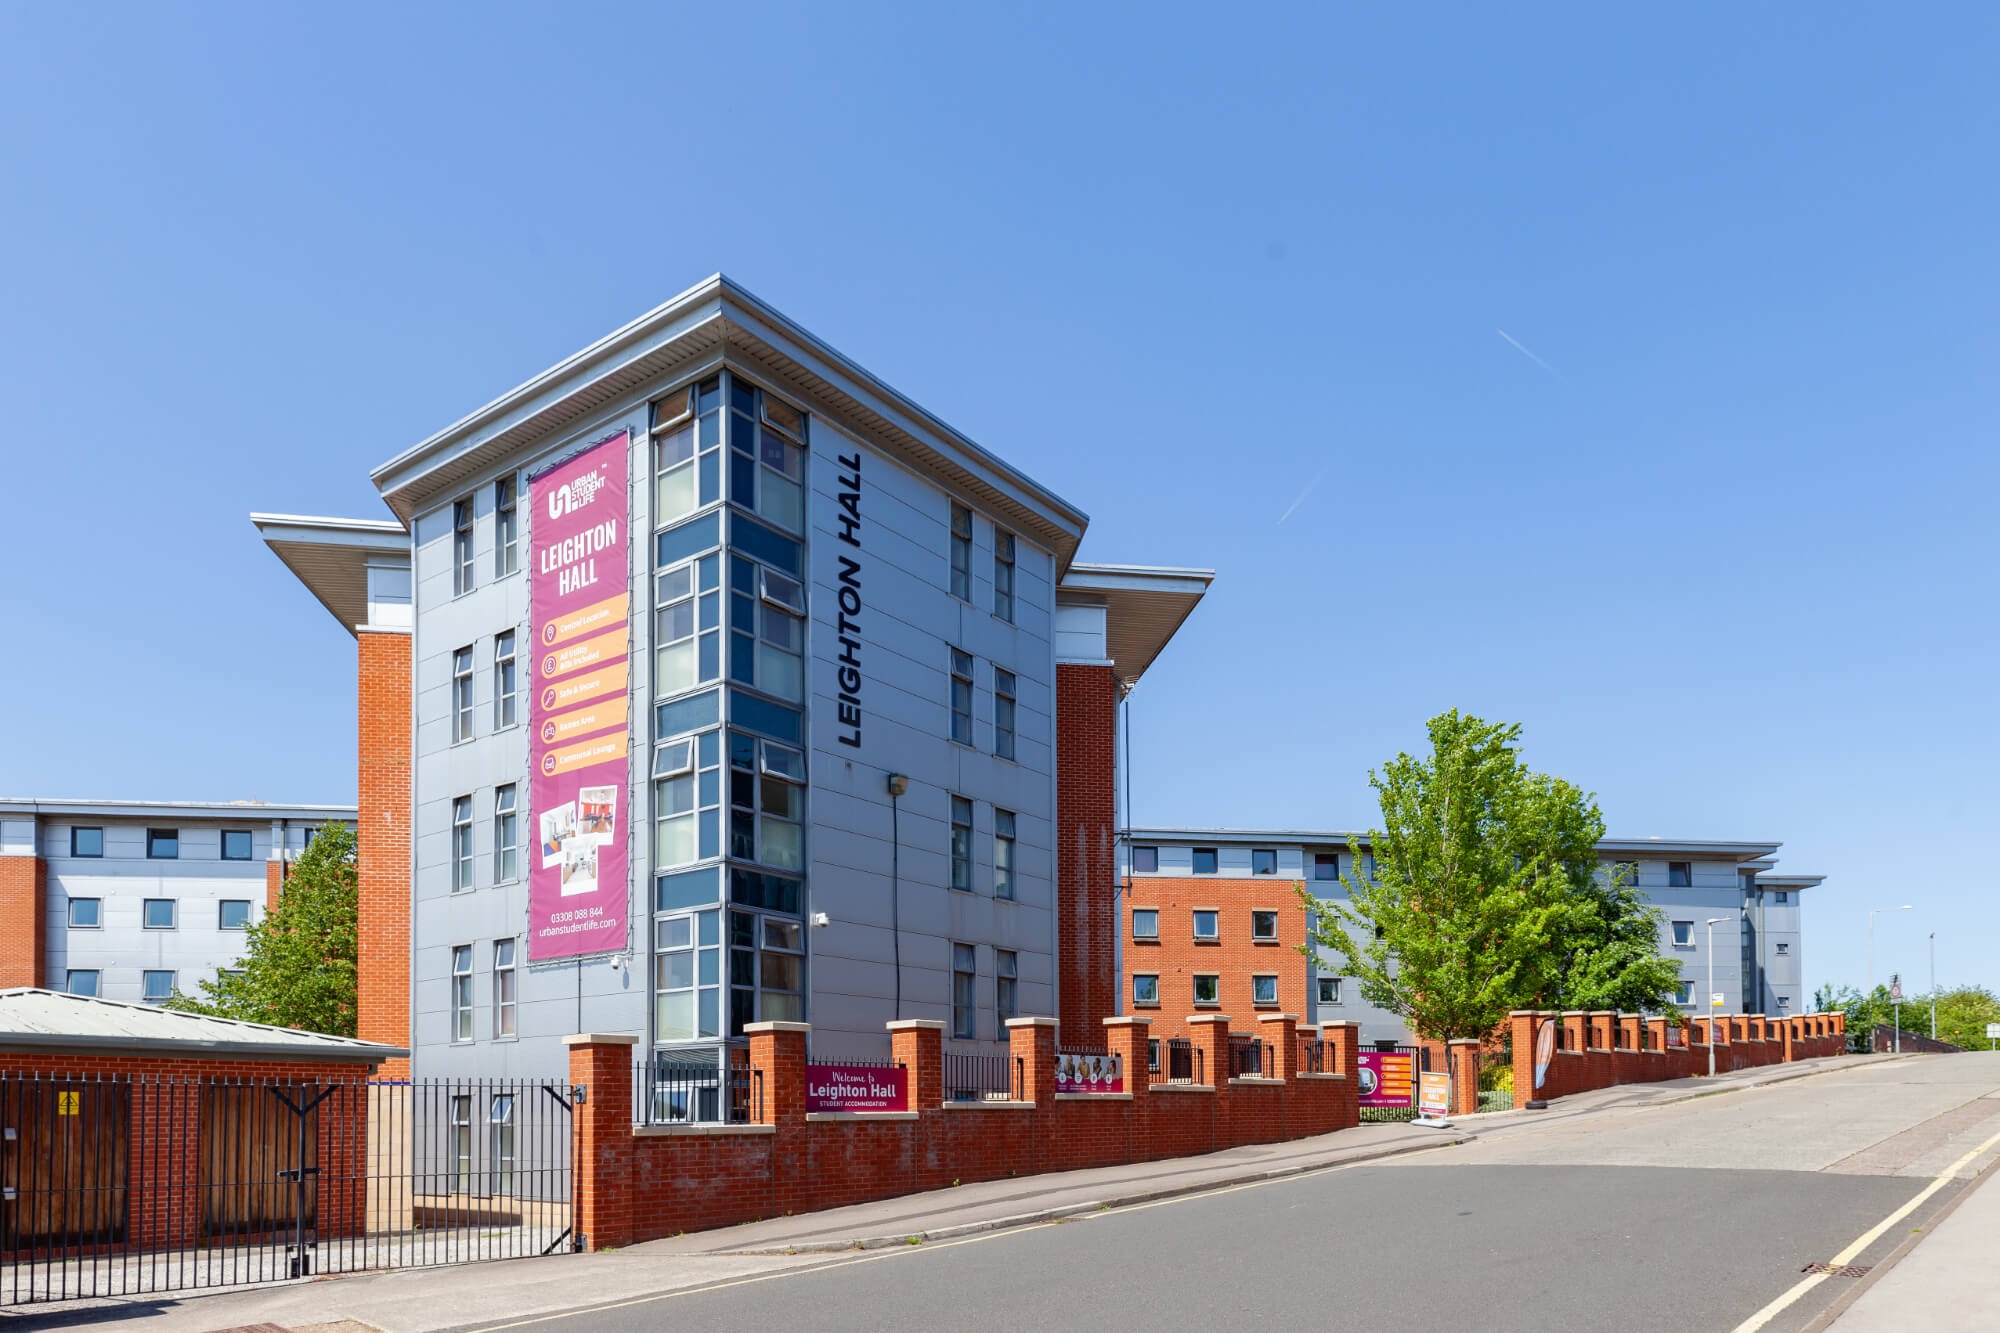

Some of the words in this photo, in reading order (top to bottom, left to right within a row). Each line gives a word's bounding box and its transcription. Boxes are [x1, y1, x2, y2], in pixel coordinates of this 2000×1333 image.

[570, 469, 597, 491] URBAN
[570, 476, 606, 501] STUDENT
[578, 491, 596, 508] LIFE
[838, 453, 861, 548] HALL
[541, 519, 617, 575] LEIGHTON
[559, 558, 598, 596] HALL
[838, 555, 861, 749] LEIGHTON
[589, 905, 603, 917] 844
[539, 918, 616, 937] urbanstudentlife.com
[832, 1071, 866, 1083] Welcome
[868, 1072, 875, 1084] to
[809, 1082, 867, 1100] Leighton
[871, 1084, 896, 1098] Hall
